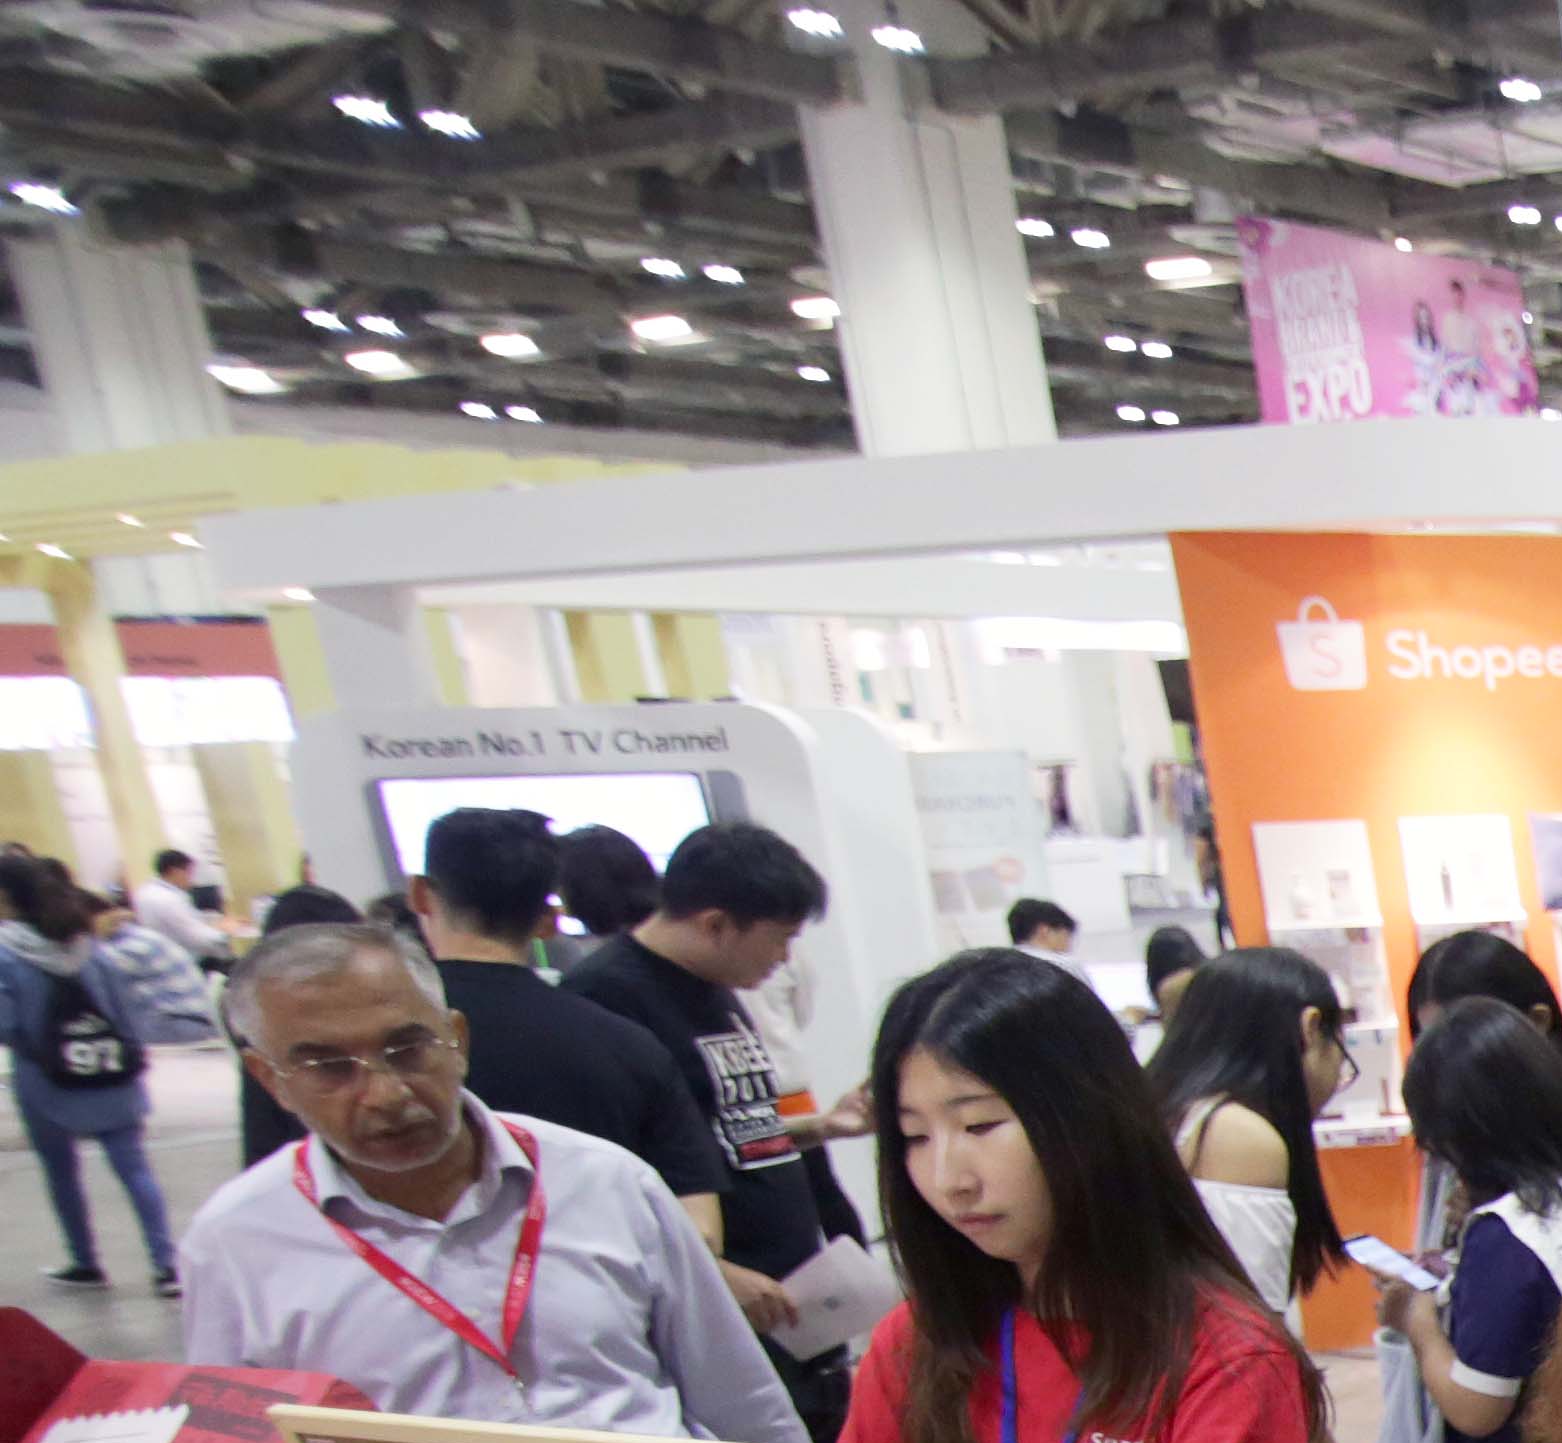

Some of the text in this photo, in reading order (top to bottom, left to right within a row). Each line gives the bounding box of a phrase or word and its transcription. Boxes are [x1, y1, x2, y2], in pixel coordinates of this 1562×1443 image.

[360, 726, 731, 760] Korean No.1 TV Channel
